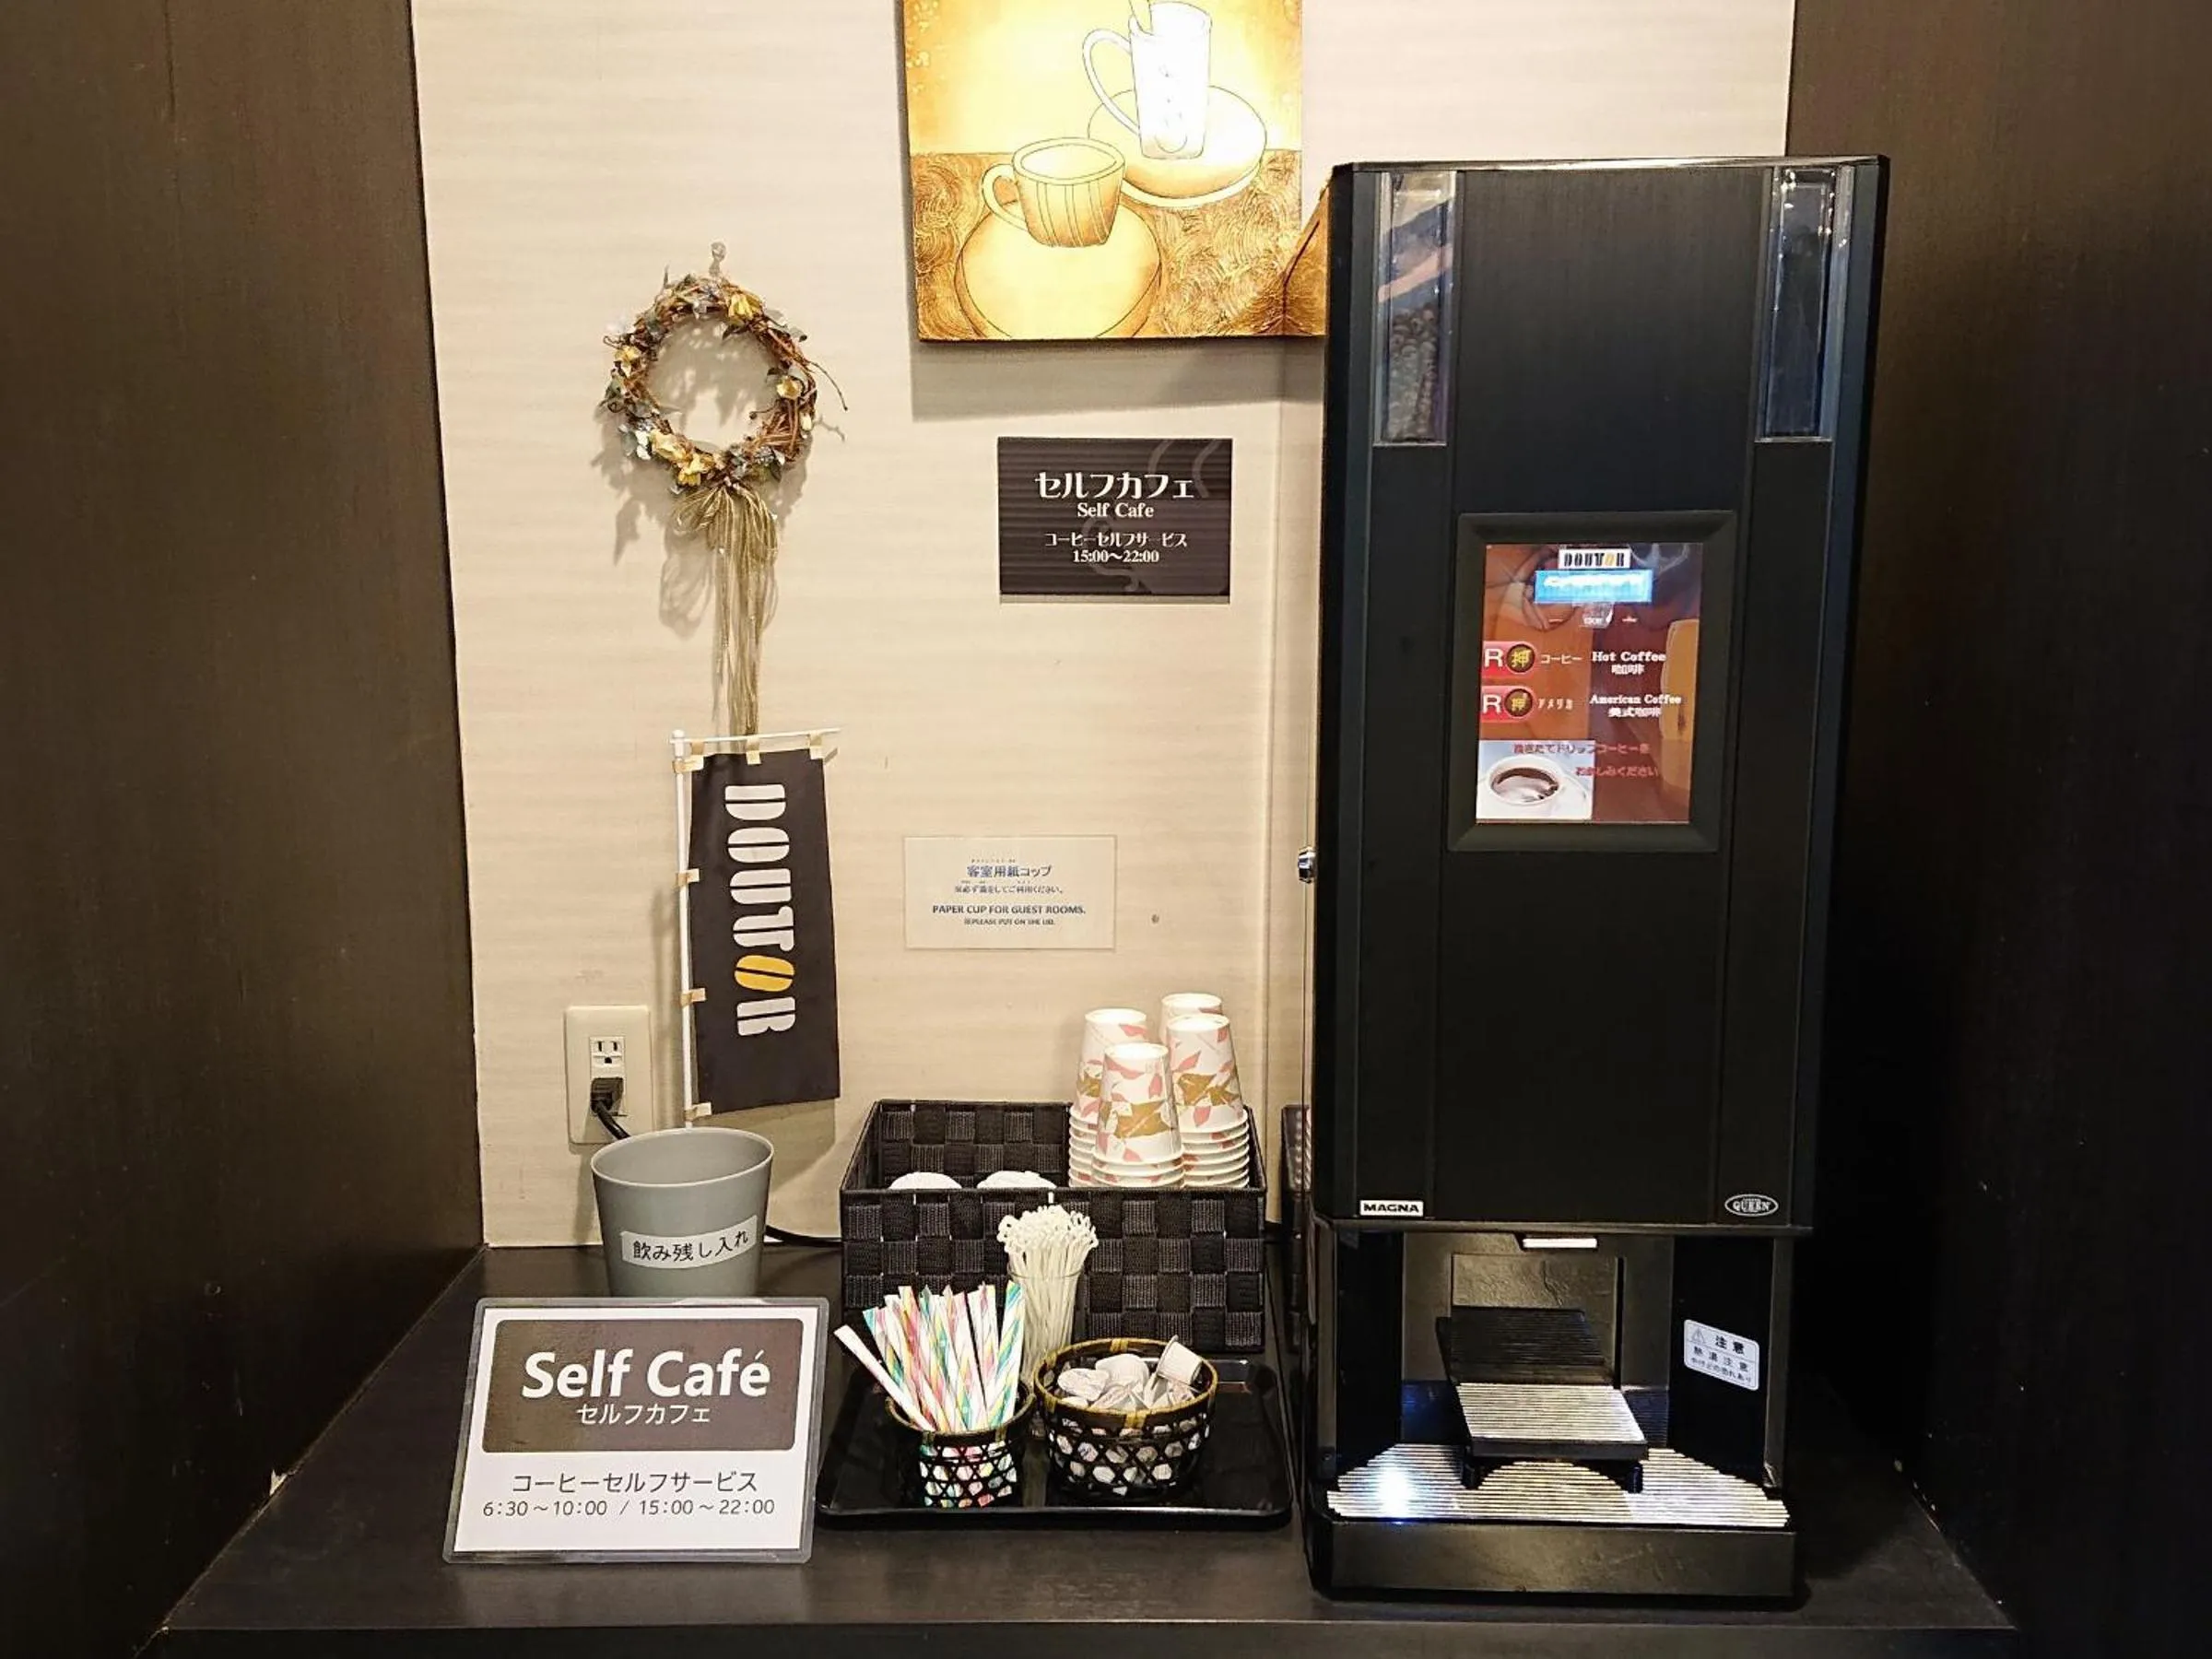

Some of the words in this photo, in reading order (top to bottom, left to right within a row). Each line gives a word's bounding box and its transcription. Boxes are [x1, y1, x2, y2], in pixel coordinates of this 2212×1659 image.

[1034, 471, 1194, 500] セルフカフェ
[1077, 502, 1111, 518] Self
[1114, 502, 1155, 518] Cafe
[1563, 552, 1625, 567] DOUTOR
[1540, 653, 1583, 665] コーヒー
[1592, 651, 1617, 663] Hot
[1620, 651, 1667, 663] Coffee
[1590, 693, 1641, 704] American
[1643, 693, 1682, 704] Coffee
[724, 783, 796, 1037] DOUTOR
[932, 904, 965, 914] PAPER
[966, 904, 988, 914] CUP
[989, 904, 1009, 914] FOR
[1011, 904, 1043, 914] GUEST
[1363, 1203, 1419, 1213] MAGNA
[1732, 1197, 1771, 1212] QUEEN
[633, 1230, 749, 1262] 飲み残し入れ
[522, 1347, 634, 1399] Self
[646, 1347, 771, 1398] Café
[576, 1403, 711, 1425] セルフカフェ
[512, 1471, 759, 1494] コーヒーセルフサービス
